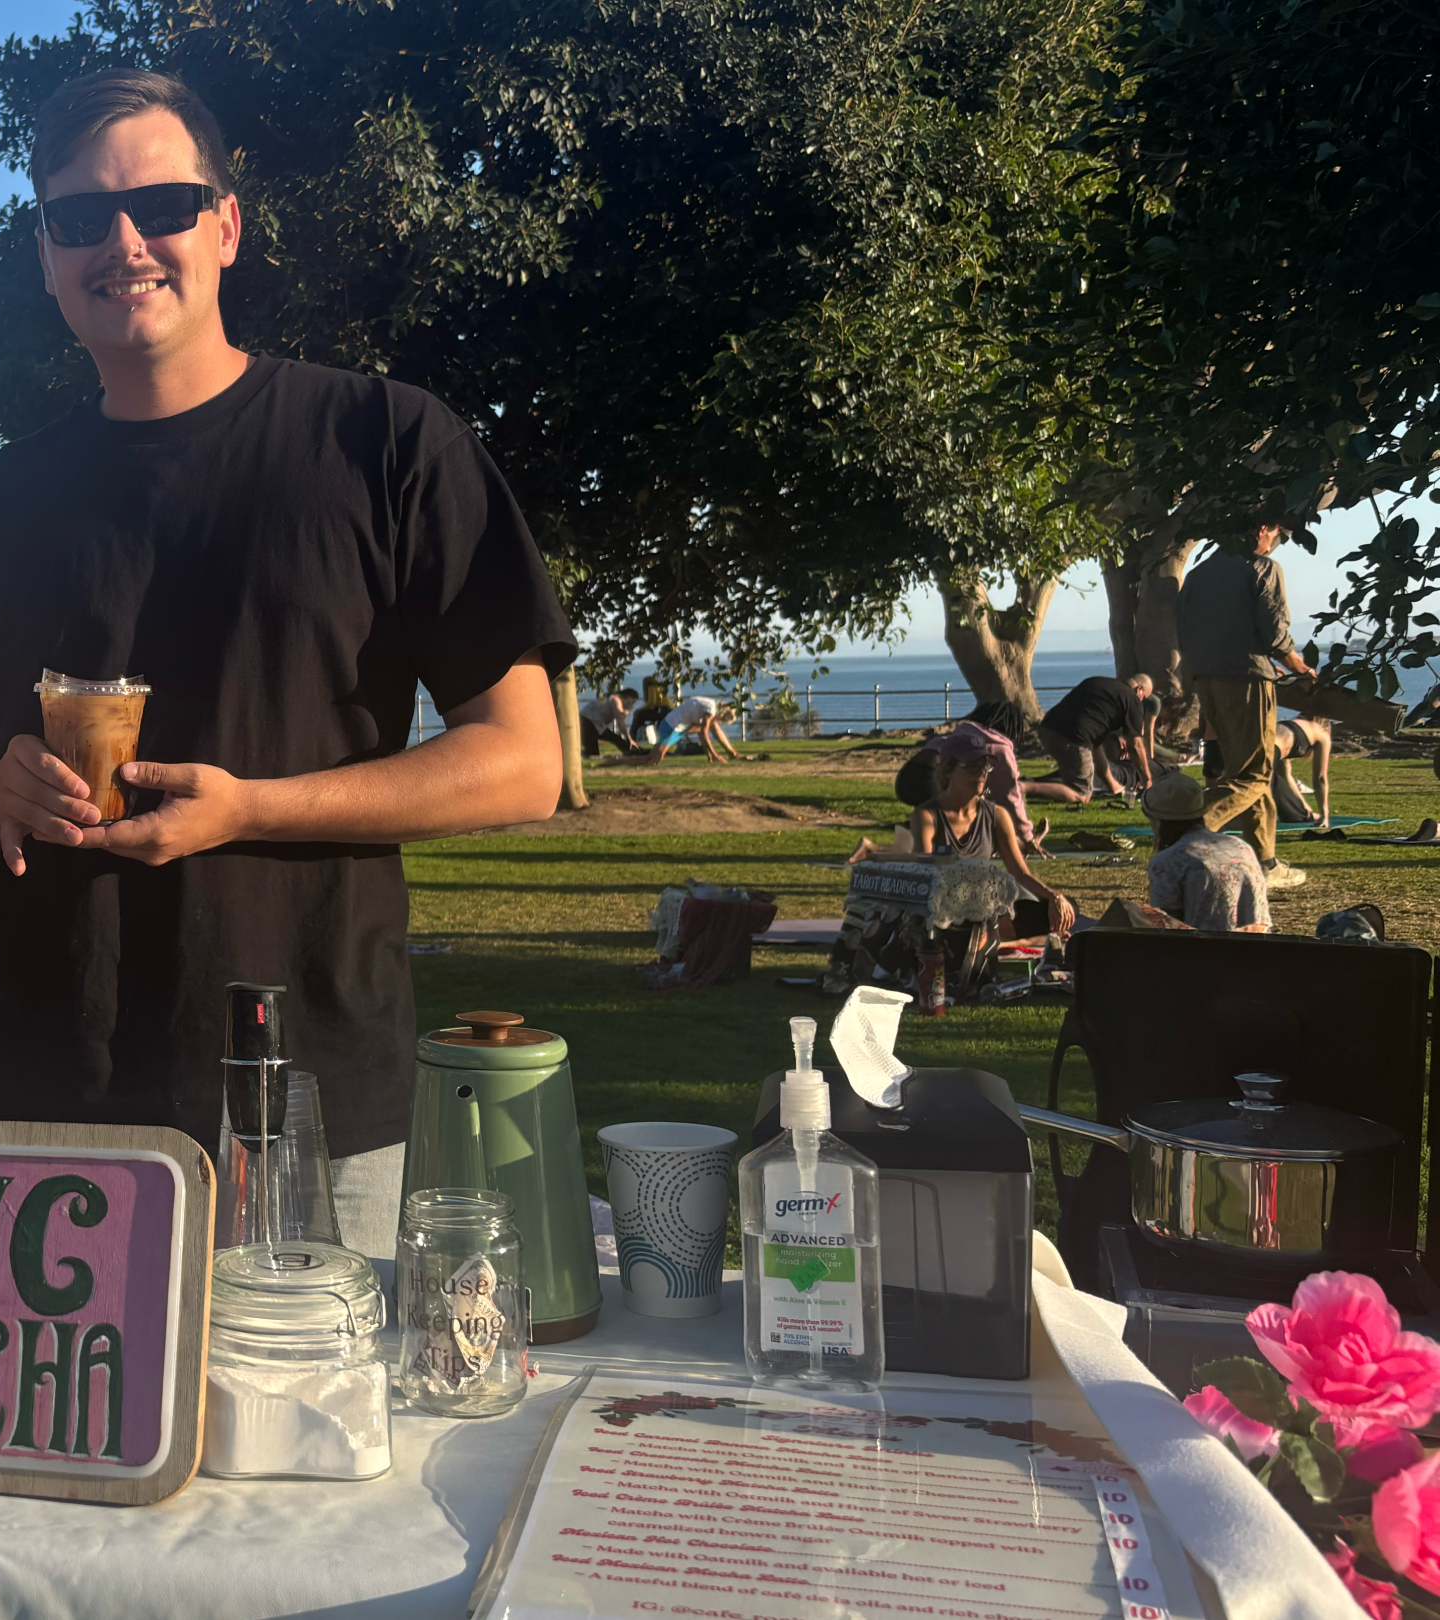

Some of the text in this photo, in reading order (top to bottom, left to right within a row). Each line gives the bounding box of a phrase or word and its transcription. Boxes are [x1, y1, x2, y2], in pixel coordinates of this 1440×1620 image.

[853, 873, 917, 896] TAROT READING
[771, 1233, 846, 1246] ADVANCED
[780, 1249, 837, 1260] moisturizing
[776, 1257, 842, 1267] hand sizer
[410, 1268, 489, 1296] House
[814, 1298, 840, 1306] Vitamin
[407, 1304, 503, 1341] Keeping
[425, 1345, 481, 1379] Tips
[822, 1346, 849, 1356] USA
[638, 1442, 697, 1454] Matcha
[701, 1448, 738, 1458] with
[741, 1452, 811, 1464] Oatmilk
[813, 1460, 845, 1468] and
[852, 1464, 899, 1474] Hints
[902, 1468, 920, 1476] of
[924, 1471, 990, 1482] Banana
[846, 1454, 894, 1464] Latte
[580, 1465, 1134, 1524] Iced Strawberry Matcha Latte 10
[623, 1459, 1020, 1505] Matcha with Oatmilk and Hints of Cheesecake
[724, 1460, 792, 1472] Matcha
[795, 1467, 842, 1477] Latte
[1102, 1492, 1127, 1503] 10
[572, 1488, 610, 1498] Iced
[739, 1504, 810, 1517] Matcha
[814, 1512, 866, 1522] Latte
[1112, 1537, 1138, 1550] 10
[616, 1480, 678, 1493] Matcha
[683, 1488, 721, 1497] with
[725, 1491, 796, 1504] Oatmilk
[800, 1500, 834, 1510] and
[838, 1502, 886, 1514] Hints
[890, 1508, 909, 1516] of
[913, 1510, 968, 1522] Sweet
[608, 1519, 834, 1545] caramelized brown sugar
[610, 1506, 674, 1518] Matcha
[678, 1512, 717, 1522] with
[848, 1528, 925, 1542] Oatmilk
[929, 1534, 996, 1550] topped
[999, 1544, 1044, 1554] with
[559, 1528, 638, 1542] Mexican
[1122, 1576, 1149, 1592] 10
[596, 1545, 1006, 1592] Made with Oatmilk and available hot or iced
[552, 1554, 592, 1564] Iced
[596, 1558, 678, 1573] Mexican
[756, 1574, 810, 1585] Latte
[1129, 1606, 1159, 1620] 10
[589, 1572, 602, 1580] A
[606, 1574, 678, 1588] tasteful
[681, 1580, 733, 1593] blend
[738, 1586, 758, 1596] of
[806, 1594, 830, 1602] de
[834, 1597, 850, 1606] la
[856, 1600, 892, 1610] olla
[896, 1604, 934, 1614] and
[938, 1608, 980, 1619] rich
[632, 1600, 664, 1612] IG:
